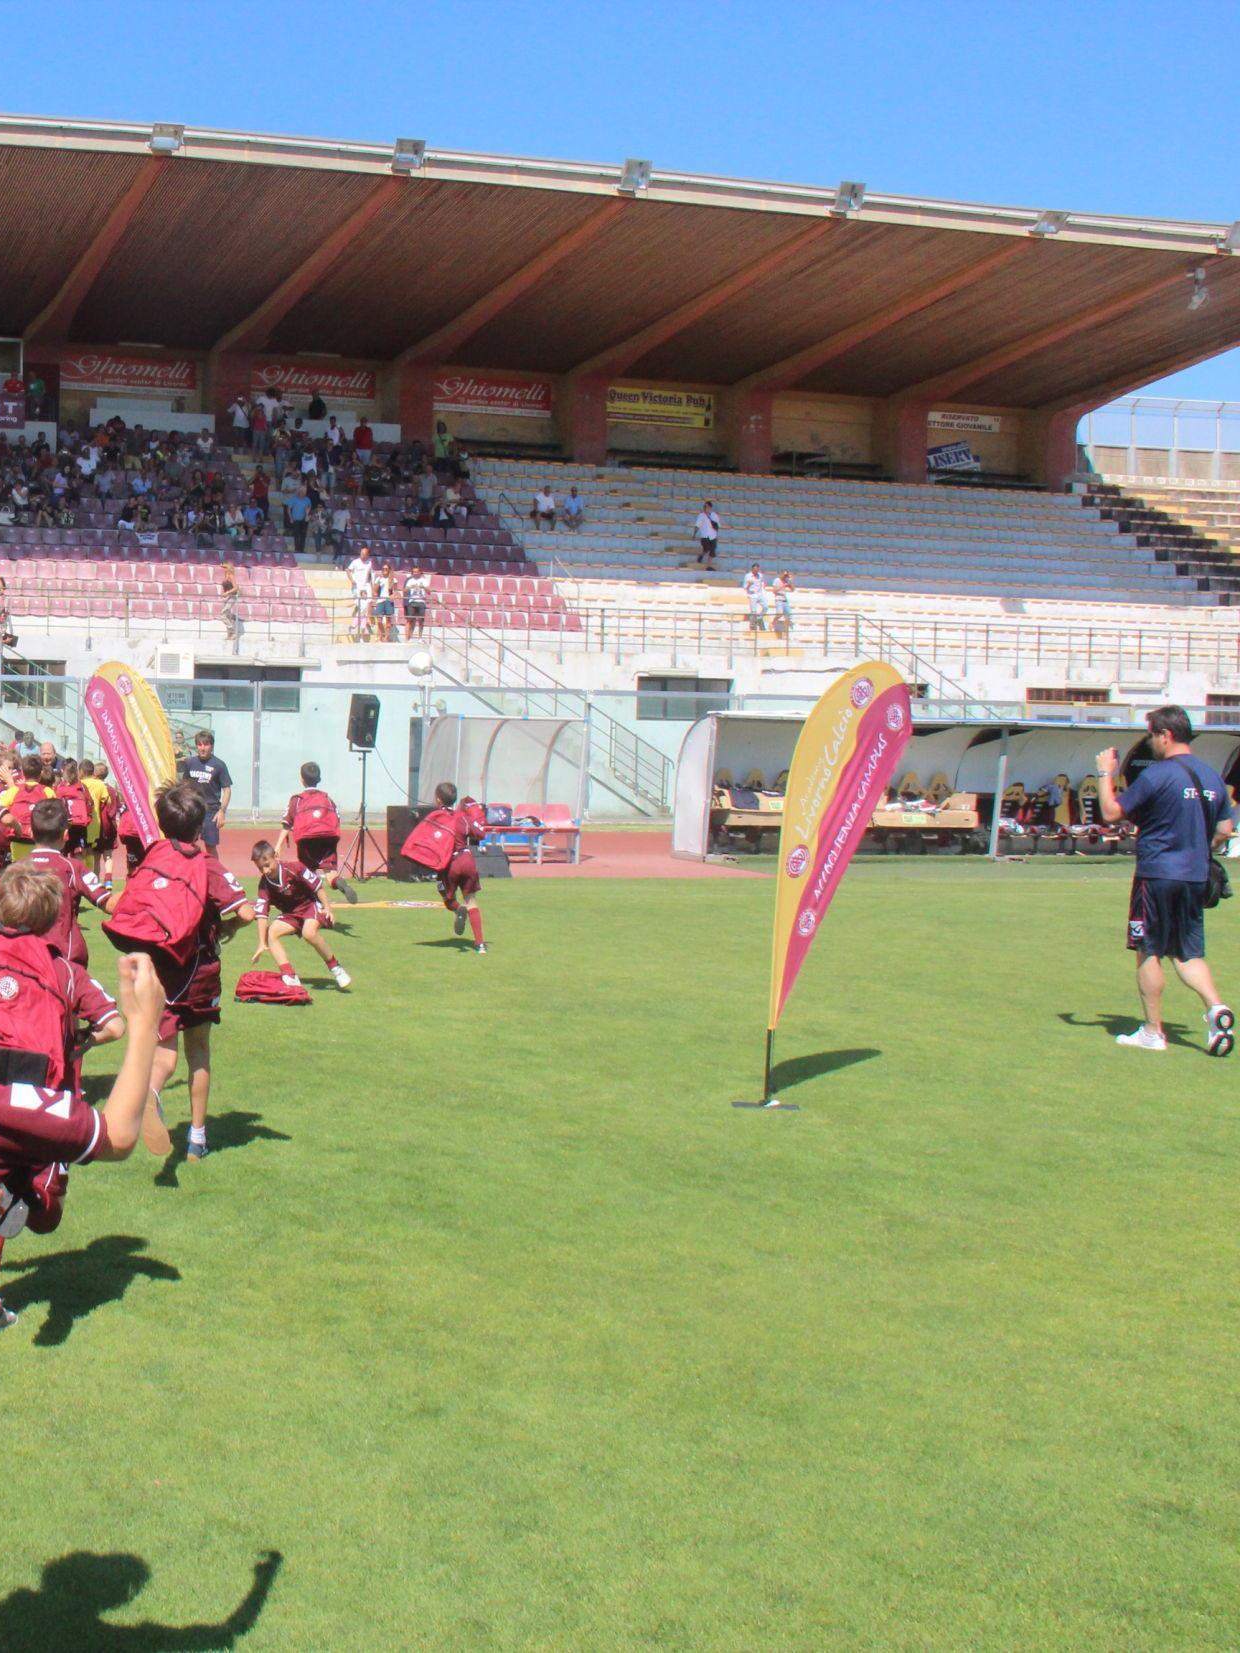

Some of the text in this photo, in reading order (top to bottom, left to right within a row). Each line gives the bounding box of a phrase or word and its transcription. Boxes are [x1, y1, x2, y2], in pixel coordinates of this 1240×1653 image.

[60, 355, 191, 379] Ghiomelli
[250, 365, 372, 389] Ghiomelli
[433, 376, 546, 400] Ghiomelli
[608, 389, 706, 407] Queen Victoria Pub
[928, 420, 954, 428] ETTORE
[794, 766, 833, 841] Livorno
[824, 707, 854, 766] Calcio
[857, 732, 888, 801] CAMPUS
